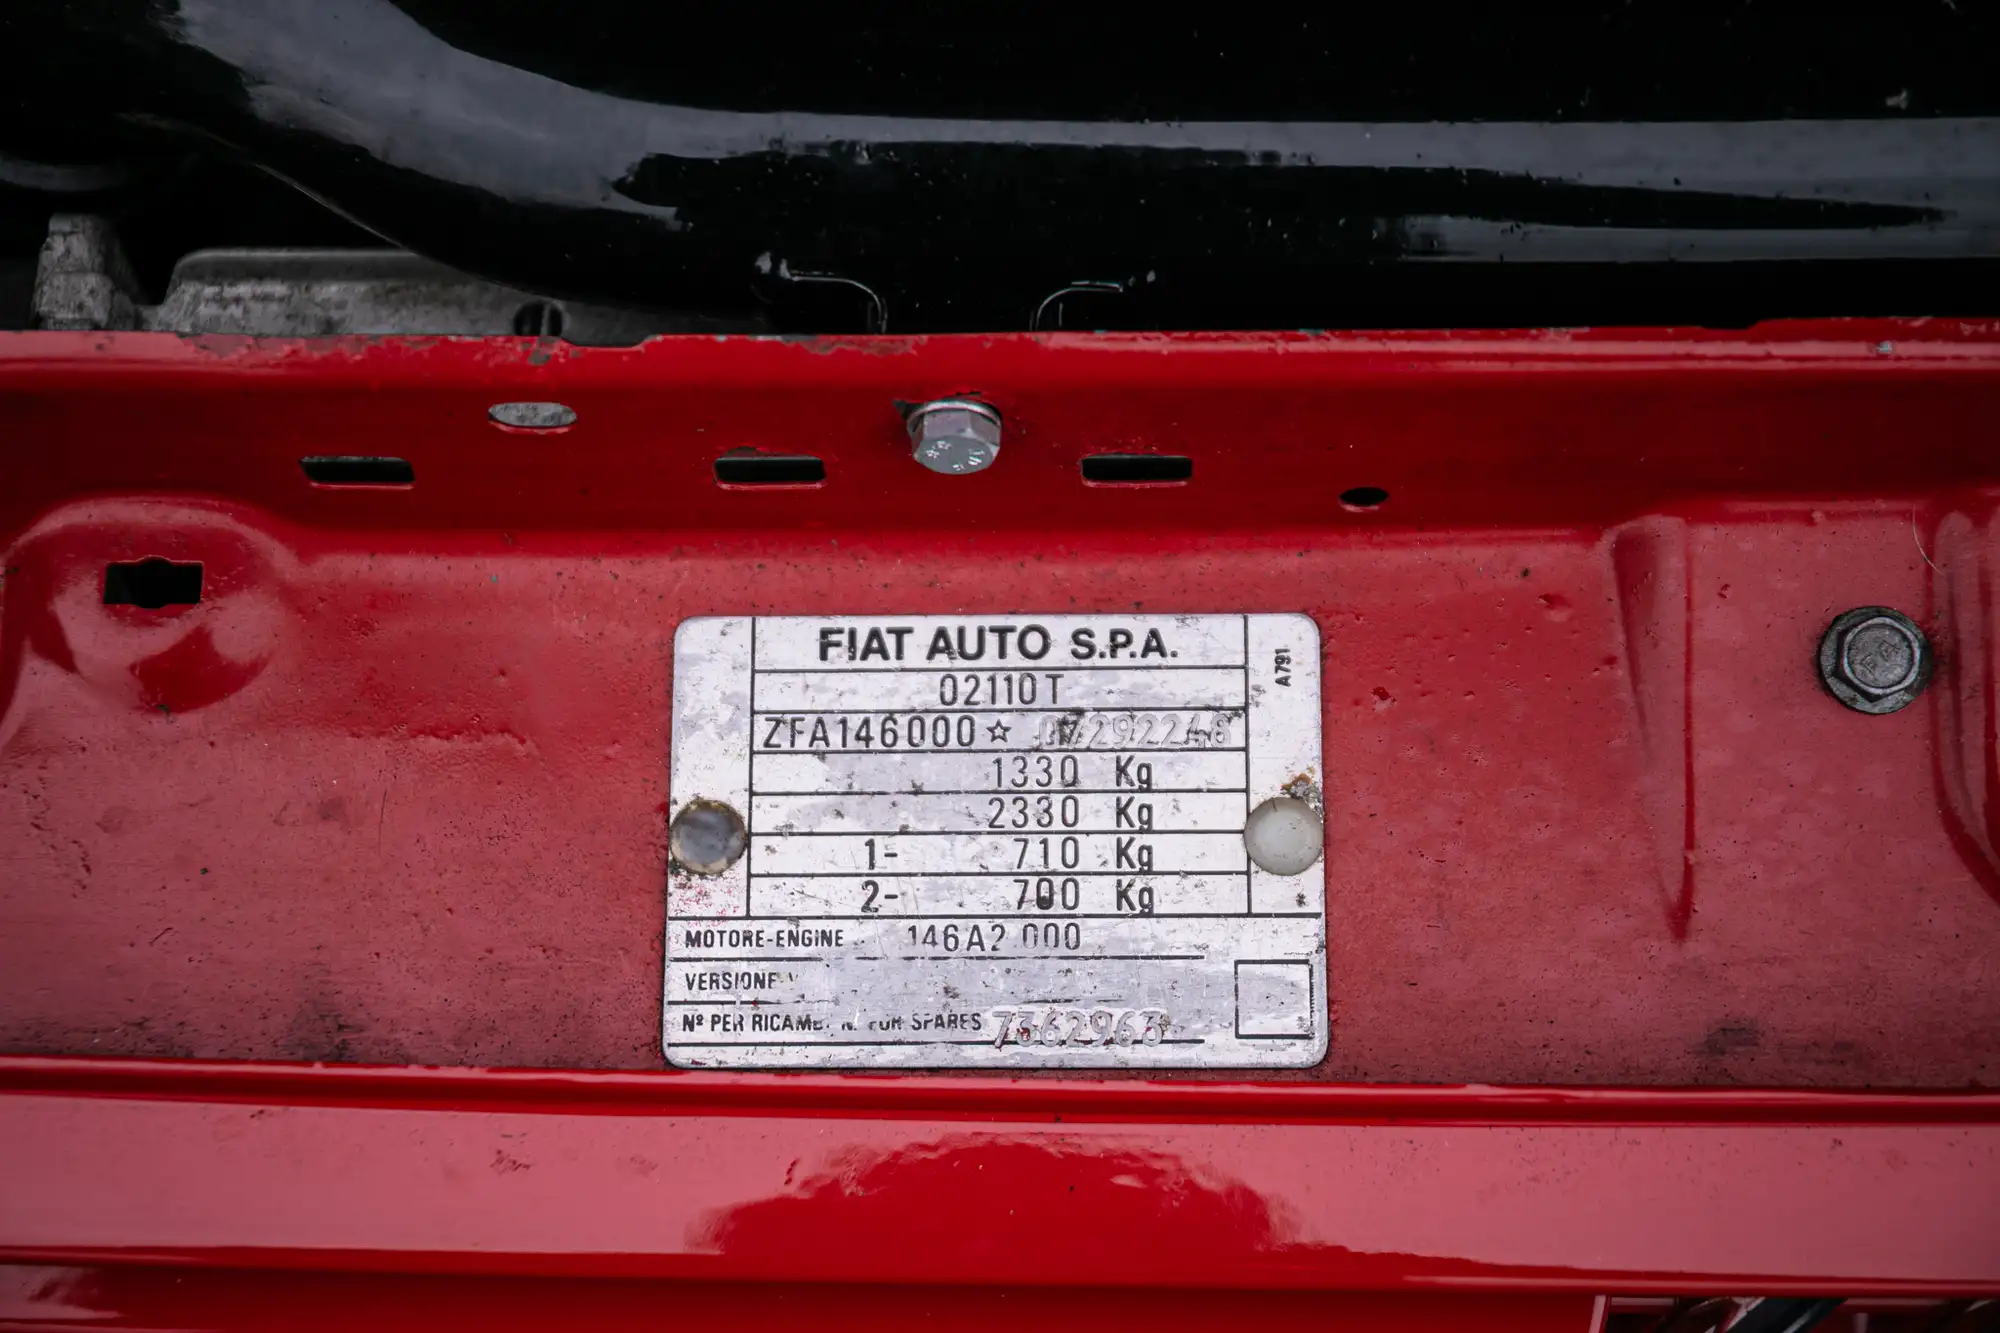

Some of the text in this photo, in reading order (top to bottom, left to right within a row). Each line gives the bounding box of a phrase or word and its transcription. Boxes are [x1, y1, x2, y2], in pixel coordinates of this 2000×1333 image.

[818, 623, 1178, 662] FIAT AUTO S.P.A.
[1274, 648, 1291, 687] A791
[763, 714, 976, 749] ZFA146000
[991, 754, 1152, 791] 1330 Kg
[987, 795, 1153, 832] 2330 Kg
[1013, 836, 1080, 870] 710
[1115, 836, 1153, 872] Kg
[1012, 877, 1080, 911] 700
[1115, 878, 1154, 915] Kg
[684, 929, 844, 948] MOTORE-ENGINE
[710, 1014, 745, 1032] PER
[911, 1012, 982, 1031] SPARES
[991, 1010, 1164, 1048] 7362963
